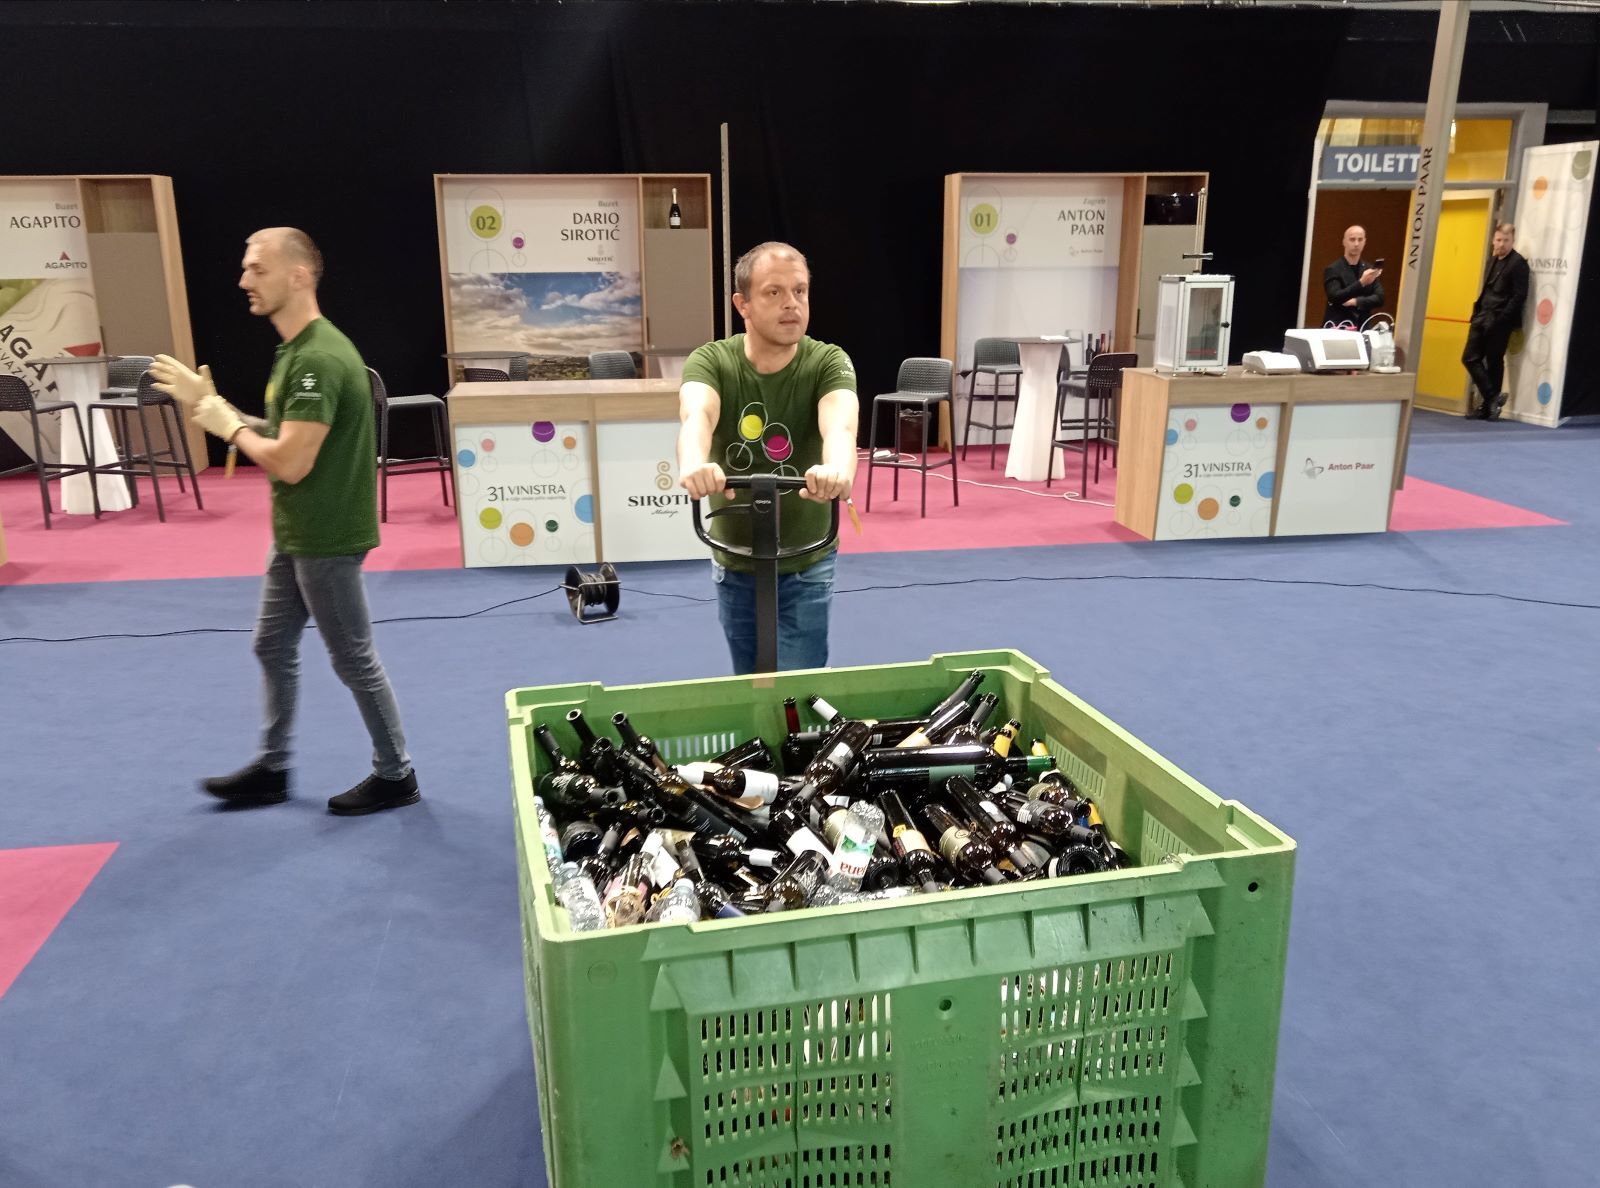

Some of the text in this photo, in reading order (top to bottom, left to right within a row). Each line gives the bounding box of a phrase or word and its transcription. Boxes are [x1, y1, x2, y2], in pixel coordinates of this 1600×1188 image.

[1334, 152, 1421, 174] TOILETT
[1057, 209, 1106, 221] ANTON
[1408, 146, 1433, 271] ANTON PAAR
[9, 215, 81, 229] AGAPITO
[475, 215, 497, 230] 02
[572, 212, 619, 225] DARIO
[974, 213, 992, 228] 01
[560, 225, 620, 241] SIROTIĆ
[1070, 224, 1105, 235] PAAR
[44, 261, 88, 270] AGAPITO
[1202, 462, 1252, 472] VINISTRA
[1328, 462, 1374, 470] Anton Paar
[507, 484, 566, 496] VINISTRA
[627, 494, 689, 508] SIROTI
